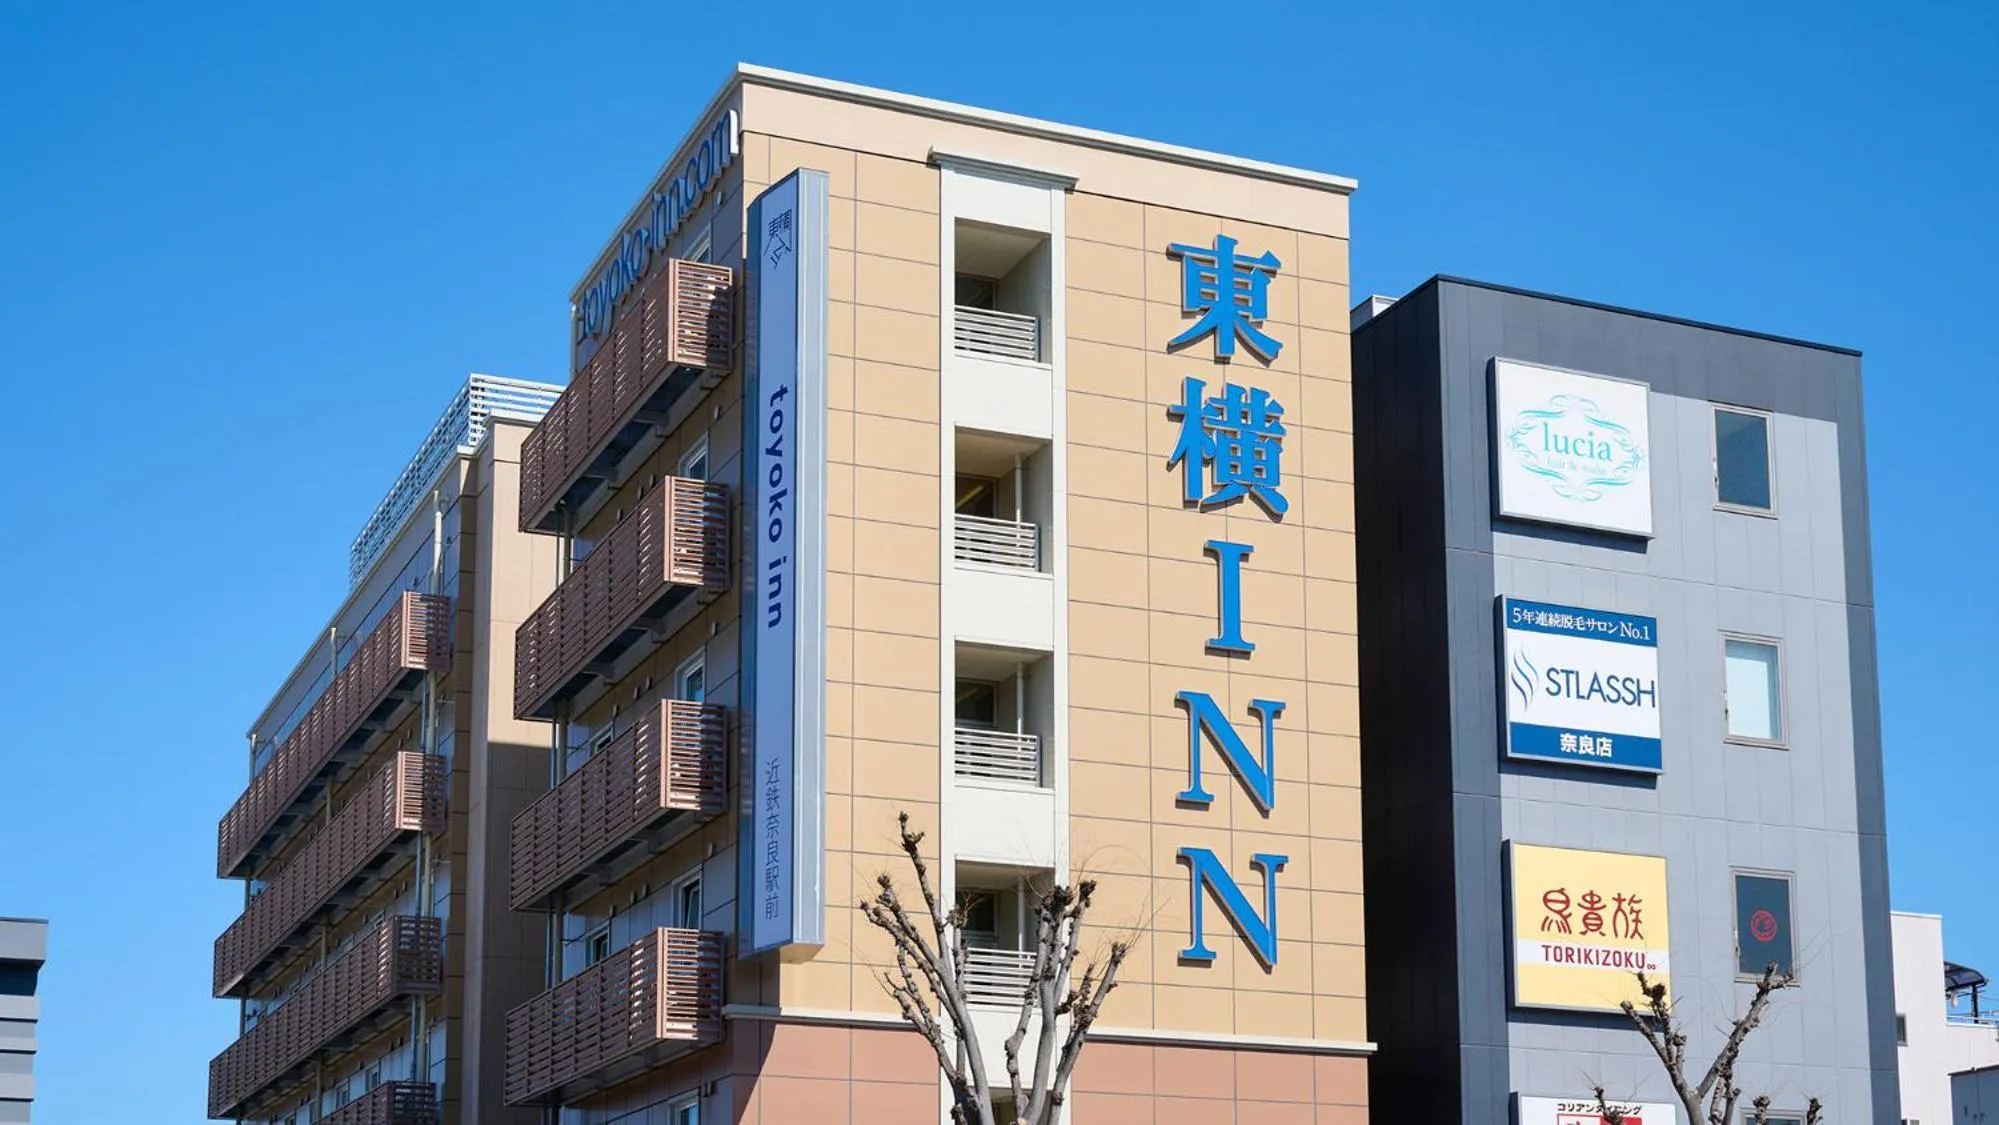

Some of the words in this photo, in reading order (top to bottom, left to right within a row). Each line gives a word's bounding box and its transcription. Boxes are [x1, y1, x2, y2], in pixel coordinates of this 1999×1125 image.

[578, 109, 739, 341] toyoko-inn.com
[765, 384, 788, 543] toyoko
[1541, 422, 1613, 462] lucia
[768, 556, 787, 629] inn
[1167, 235, 1289, 974] 東横INN
[1545, 667, 1656, 708] STLASSH
[1560, 733, 1613, 757] 奈良店
[765, 757, 781, 921] 近鉄奈良駅前
[1541, 887, 1644, 940] 鳥貴族
[1541, 944, 1646, 970] TORIKIZOKU
